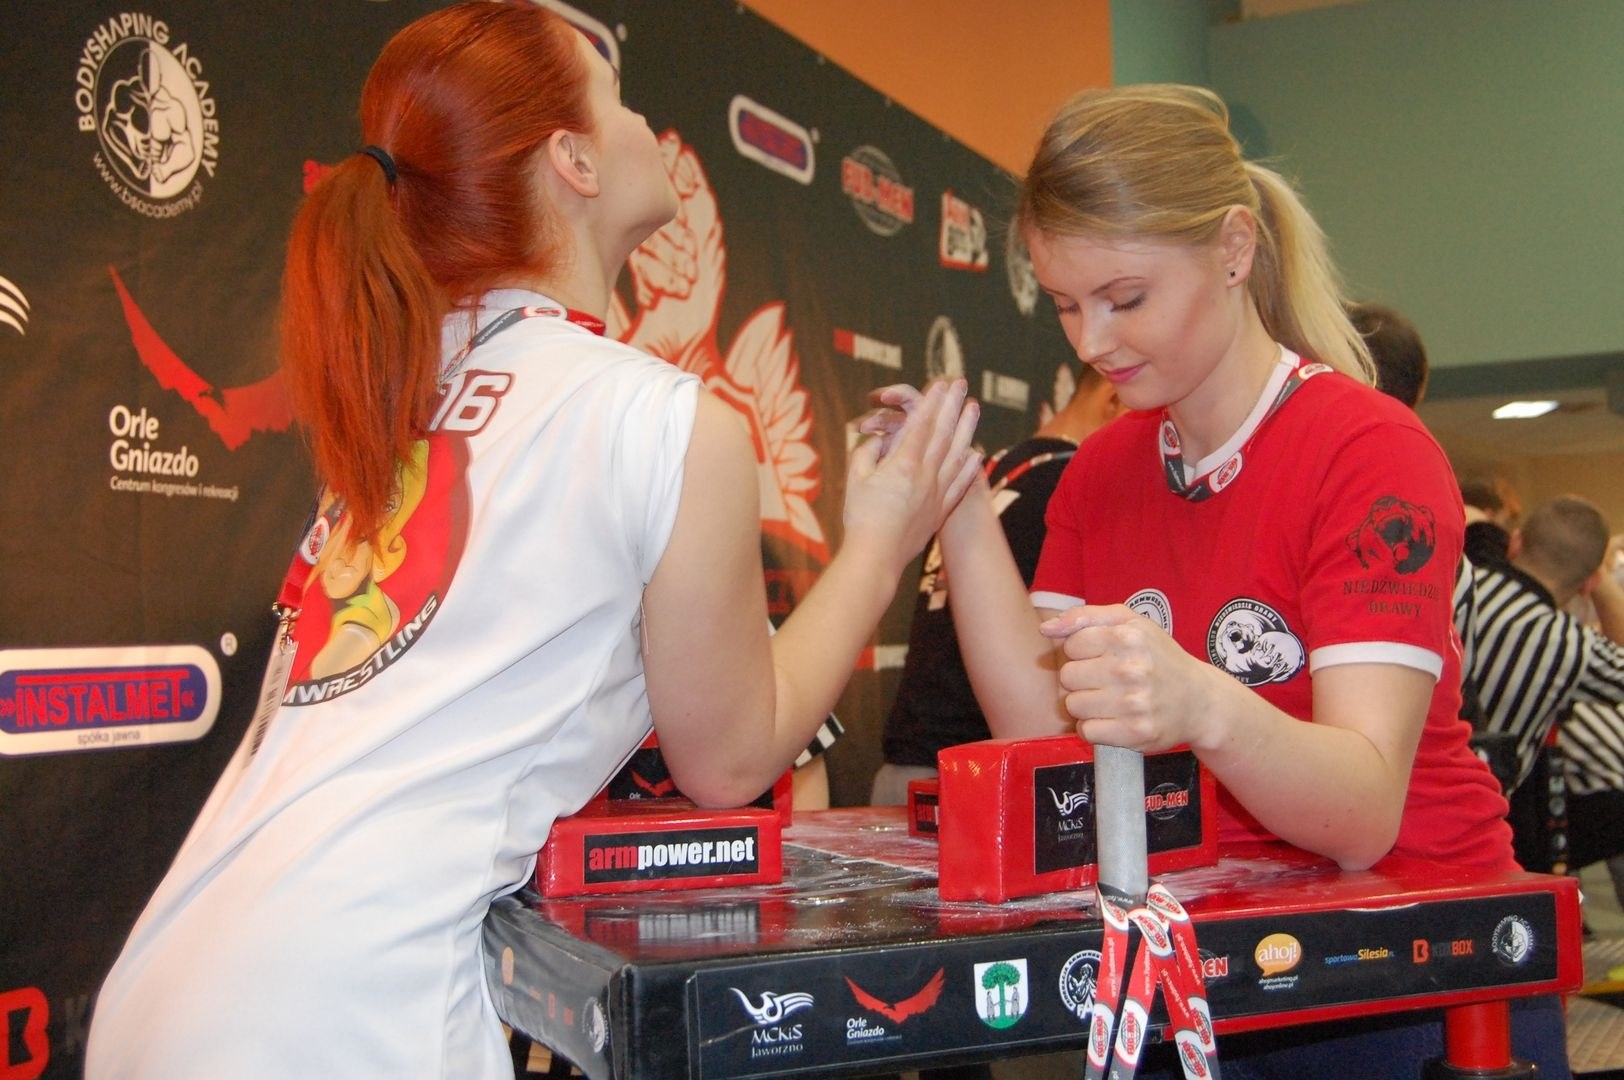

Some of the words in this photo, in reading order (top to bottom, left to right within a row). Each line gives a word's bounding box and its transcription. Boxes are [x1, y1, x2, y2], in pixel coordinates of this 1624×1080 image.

[75, 12, 170, 132] BODYSHAPING
[172, 42, 219, 178] ACADEMY
[109, 405, 159, 440] Orle
[110, 439, 199, 477] Gniazdo
[110, 475, 151, 492] Centrum
[111, 730, 141, 744] jawna
[589, 837, 755, 872] armpower.net
[1259, 942, 1298, 963] ahoj!
[846, 1017, 868, 1029] Orle
[846, 1025, 885, 1040] Gniazdo
